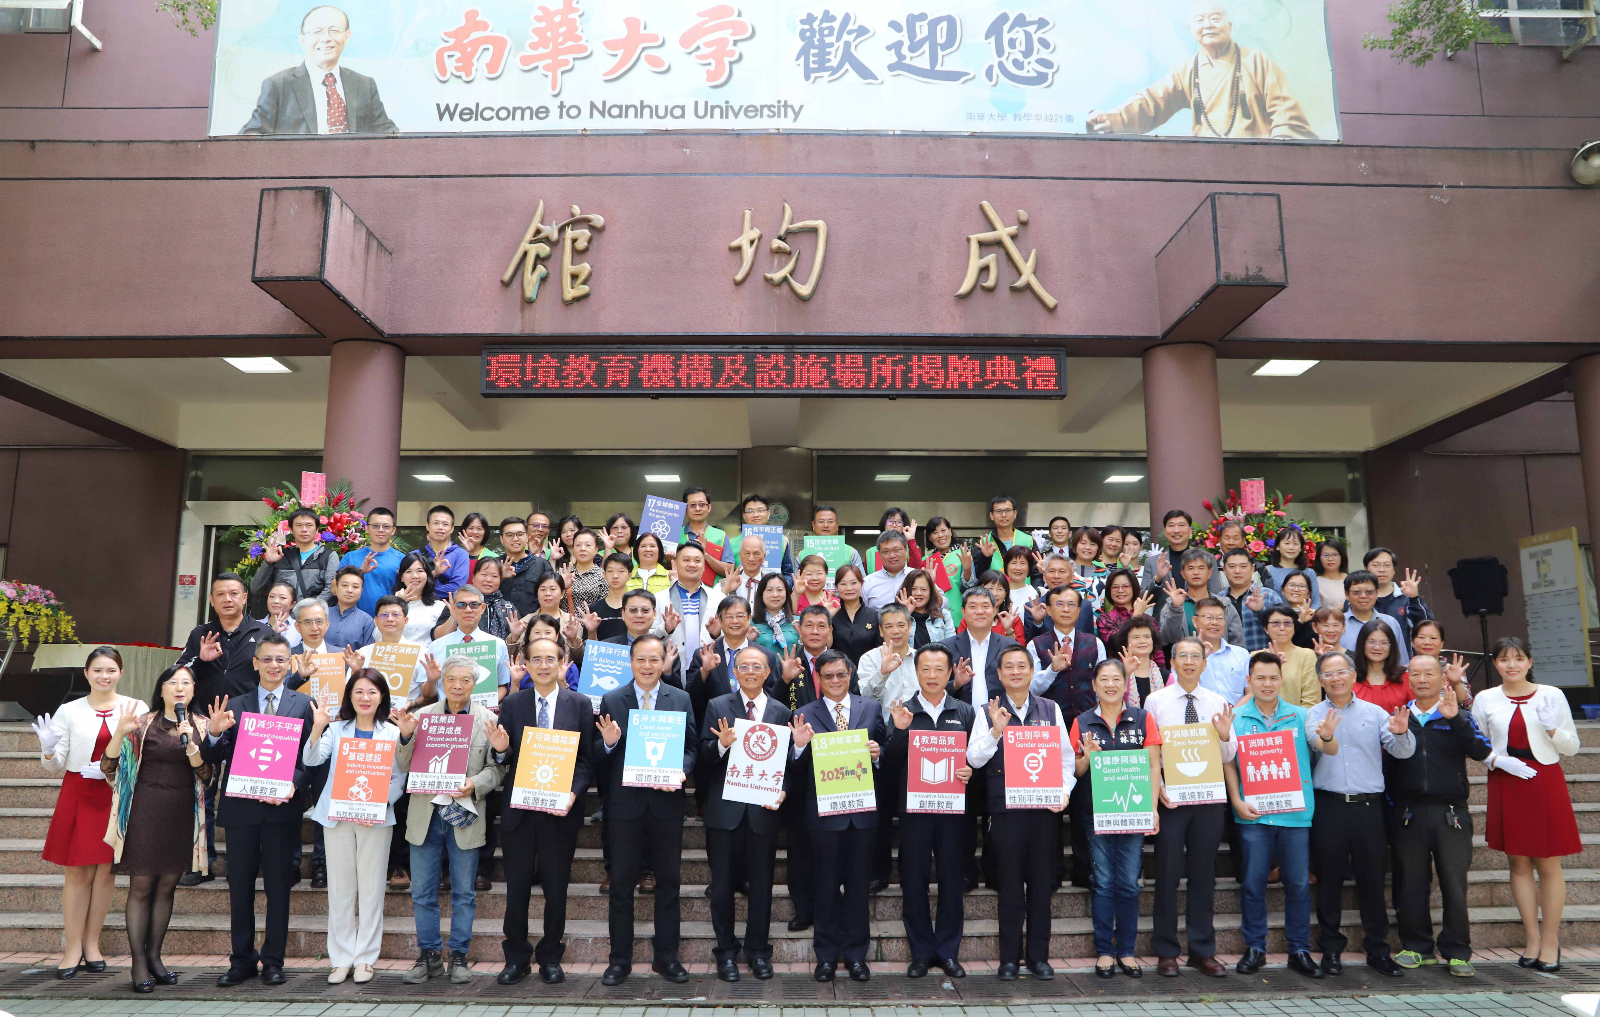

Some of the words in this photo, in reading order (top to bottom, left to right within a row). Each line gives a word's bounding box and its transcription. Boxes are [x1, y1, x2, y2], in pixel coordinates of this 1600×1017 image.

[794, 9, 1057, 87] 歡迎您
[436, 102, 550, 122] Welcome
[558, 101, 581, 119] to
[590, 100, 685, 119] Nanhua
[694, 100, 804, 123] University
[486, 353, 1060, 391] 環境教育機構及設施場所揭牌典禮
[648, 499, 656, 507] 17
[806, 539, 814, 548] 15
[375, 646, 385, 656] 12
[588, 644, 598, 656] 14
[244, 718, 257, 731] 10
[257, 719, 302, 733] 減少不平等
[422, 718, 429, 730] 8
[633, 714, 640, 725] 6
[640, 714, 684, 724] 淨水與衛生
[248, 731, 270, 739] Reduced
[271, 733, 300, 741] inequalities
[428, 726, 462, 735] 經濟成長
[526, 732, 534, 744] 7
[813, 738, 828, 750] 18
[828, 734, 862, 746] 非核家園
[913, 735, 920, 748] 4
[921, 735, 956, 745] 教育品質
[1008, 731, 1014, 743] 5
[1016, 731, 1049, 740] 性別平等
[1164, 731, 1171, 743] 2
[342, 742, 350, 755] 9
[532, 743, 562, 752] Affordable
[1240, 741, 1245, 752] 1
[1248, 736, 1283, 748] 消除貧窮
[348, 752, 382, 762] 基礎建設
[1260, 748, 1283, 756] poverty
[1095, 756, 1102, 769] 3
[1102, 755, 1147, 765] 健康與福祉
[820, 766, 845, 782] 2025
[240, 784, 278, 796] 人權教育
[726, 779, 749, 788] Nanhua
[750, 783, 780, 794] University
[1009, 795, 1060, 804] 性別平等教育
[1178, 791, 1214, 800] 環境教育
[830, 799, 864, 810] 環境教育
[919, 800, 953, 809] 創新教育
[1258, 800, 1292, 810] 品德教育
